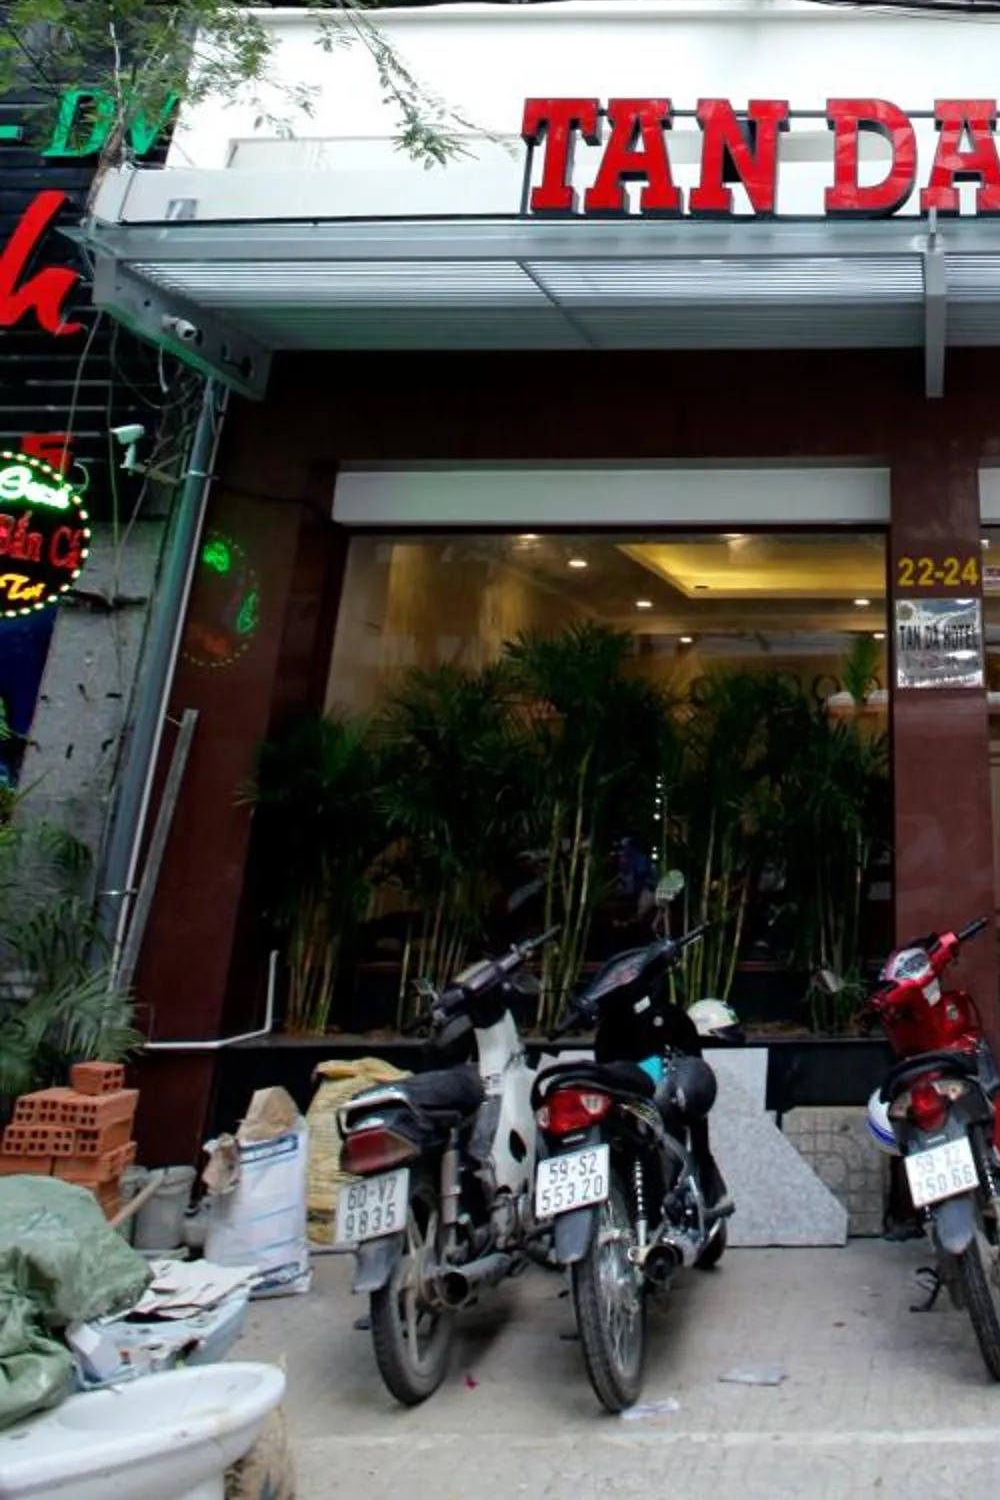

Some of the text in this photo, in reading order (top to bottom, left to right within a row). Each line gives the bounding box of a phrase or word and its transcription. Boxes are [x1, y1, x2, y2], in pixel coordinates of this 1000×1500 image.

[521, 98, 790, 219] TAN
[898, 556, 980, 587] 22-24
[345, 1201, 396, 1239] 9835
